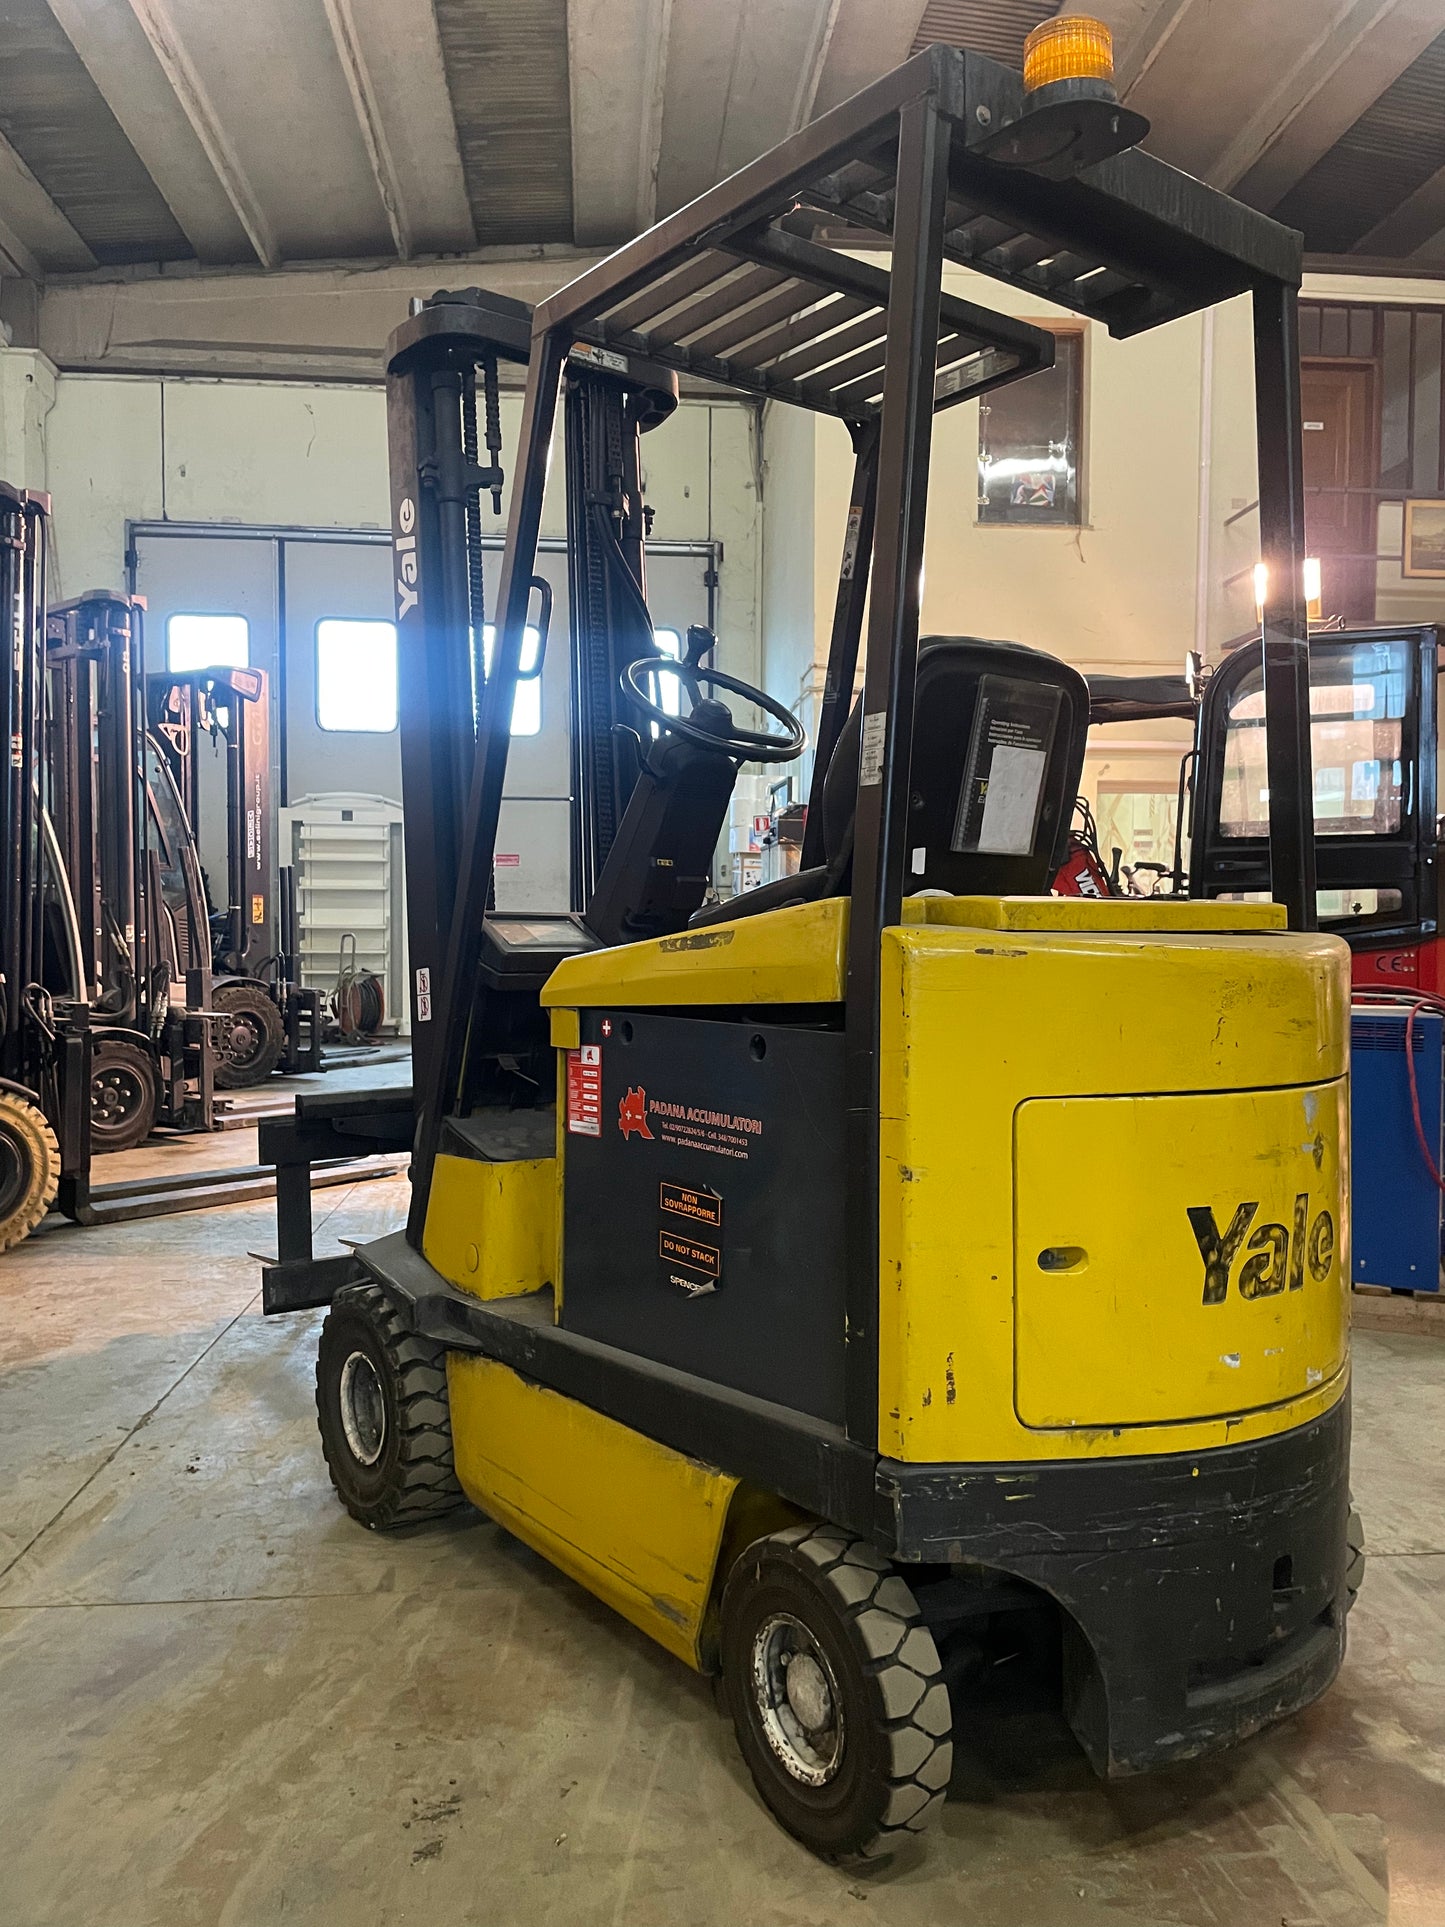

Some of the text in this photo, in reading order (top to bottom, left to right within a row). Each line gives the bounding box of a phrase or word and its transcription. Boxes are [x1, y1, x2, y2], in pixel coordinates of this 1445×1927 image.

[396, 498, 418, 621] Yale
[649, 1099, 762, 1135] PADANA ACCUMULATORI
[664, 1197, 716, 1221] SOVRAPPORRE
[681, 1192, 698, 1205] NON
[663, 1239, 715, 1265] DO NOT STACK
[1186, 1192, 1334, 1306] Yale
